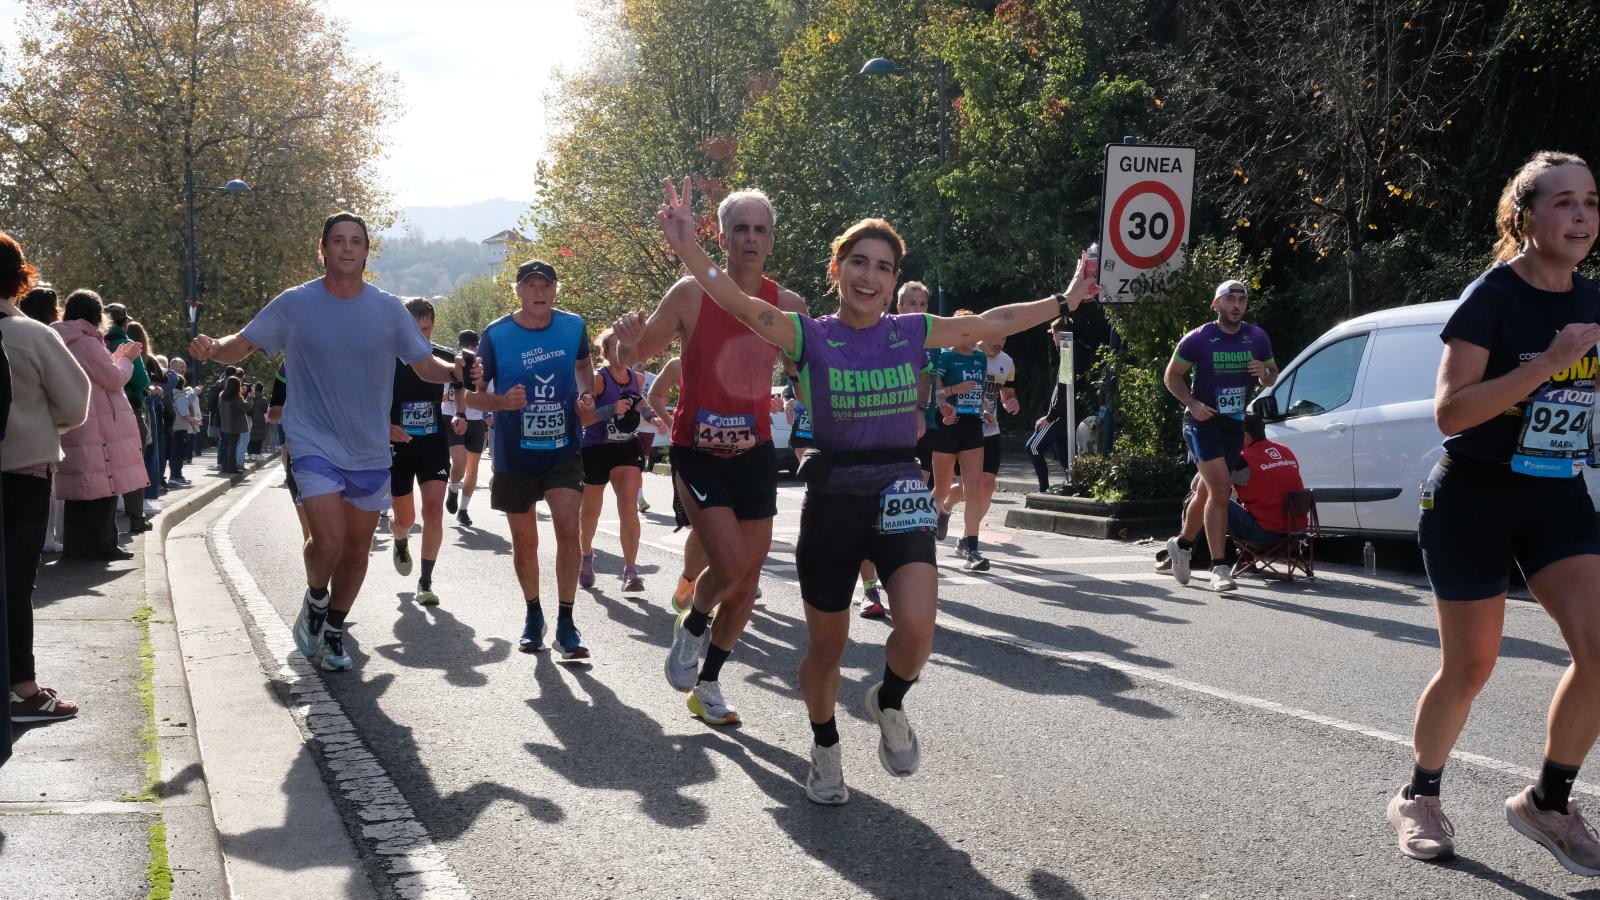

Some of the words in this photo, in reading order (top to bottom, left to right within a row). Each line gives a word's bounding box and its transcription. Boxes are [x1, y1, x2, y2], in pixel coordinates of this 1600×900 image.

[1119, 156, 1183, 174] GUNEA
[1127, 211, 1169, 241] 30
[521, 347, 543, 359] SALTO
[523, 349, 566, 366] FOUNDATION
[1212, 350, 1253, 362] BEHOBIA
[828, 362, 916, 393] BEHOBIA
[830, 394, 856, 409] SAN
[524, 412, 564, 429] 7553
[884, 518, 917, 529] MARINA
